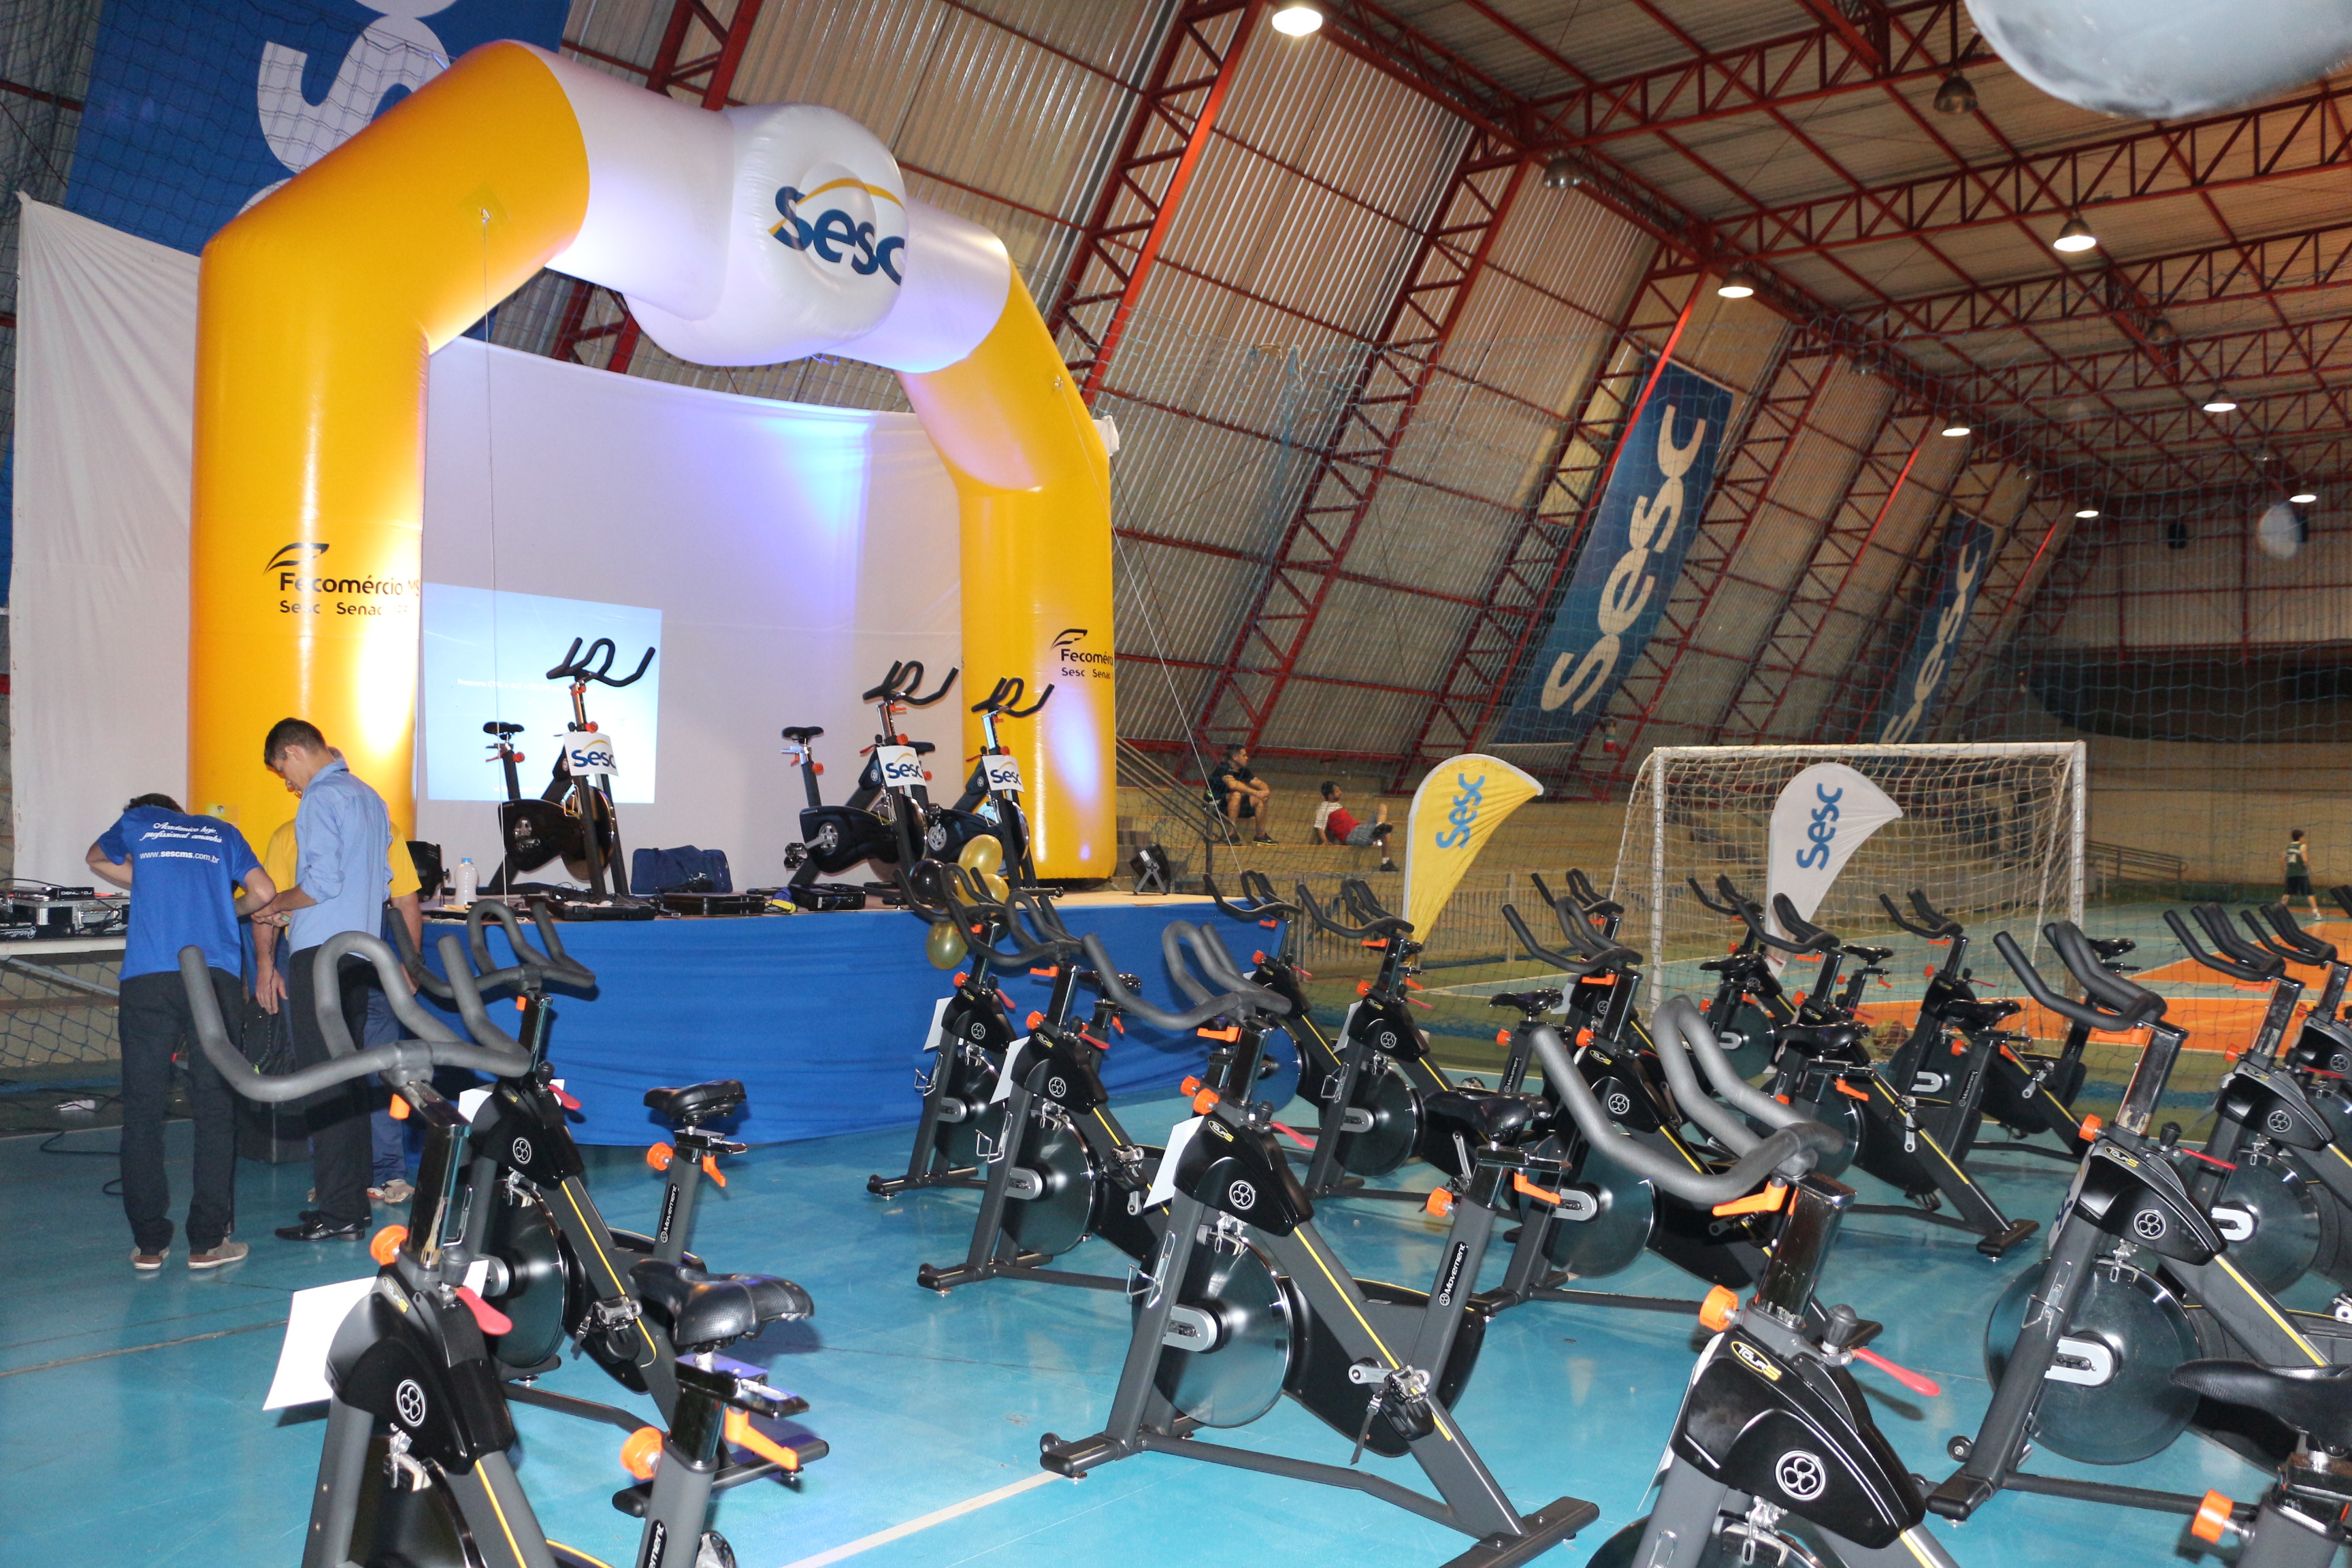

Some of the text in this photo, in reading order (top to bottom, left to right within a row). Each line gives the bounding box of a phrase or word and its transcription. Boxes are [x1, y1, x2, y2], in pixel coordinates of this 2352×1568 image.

[280, 572, 402, 595] Fecomércio
[280, 600, 320, 614] Sesc
[337, 602, 383, 615] Senac
[1062, 668, 1111, 679] Sesc Senac
[140, 830, 190, 841] profissional
[140, 851, 220, 864] www.sescms.com.br
[664, 1185, 677, 1232] Movement
[1444, 1243, 1466, 1294] Movement
